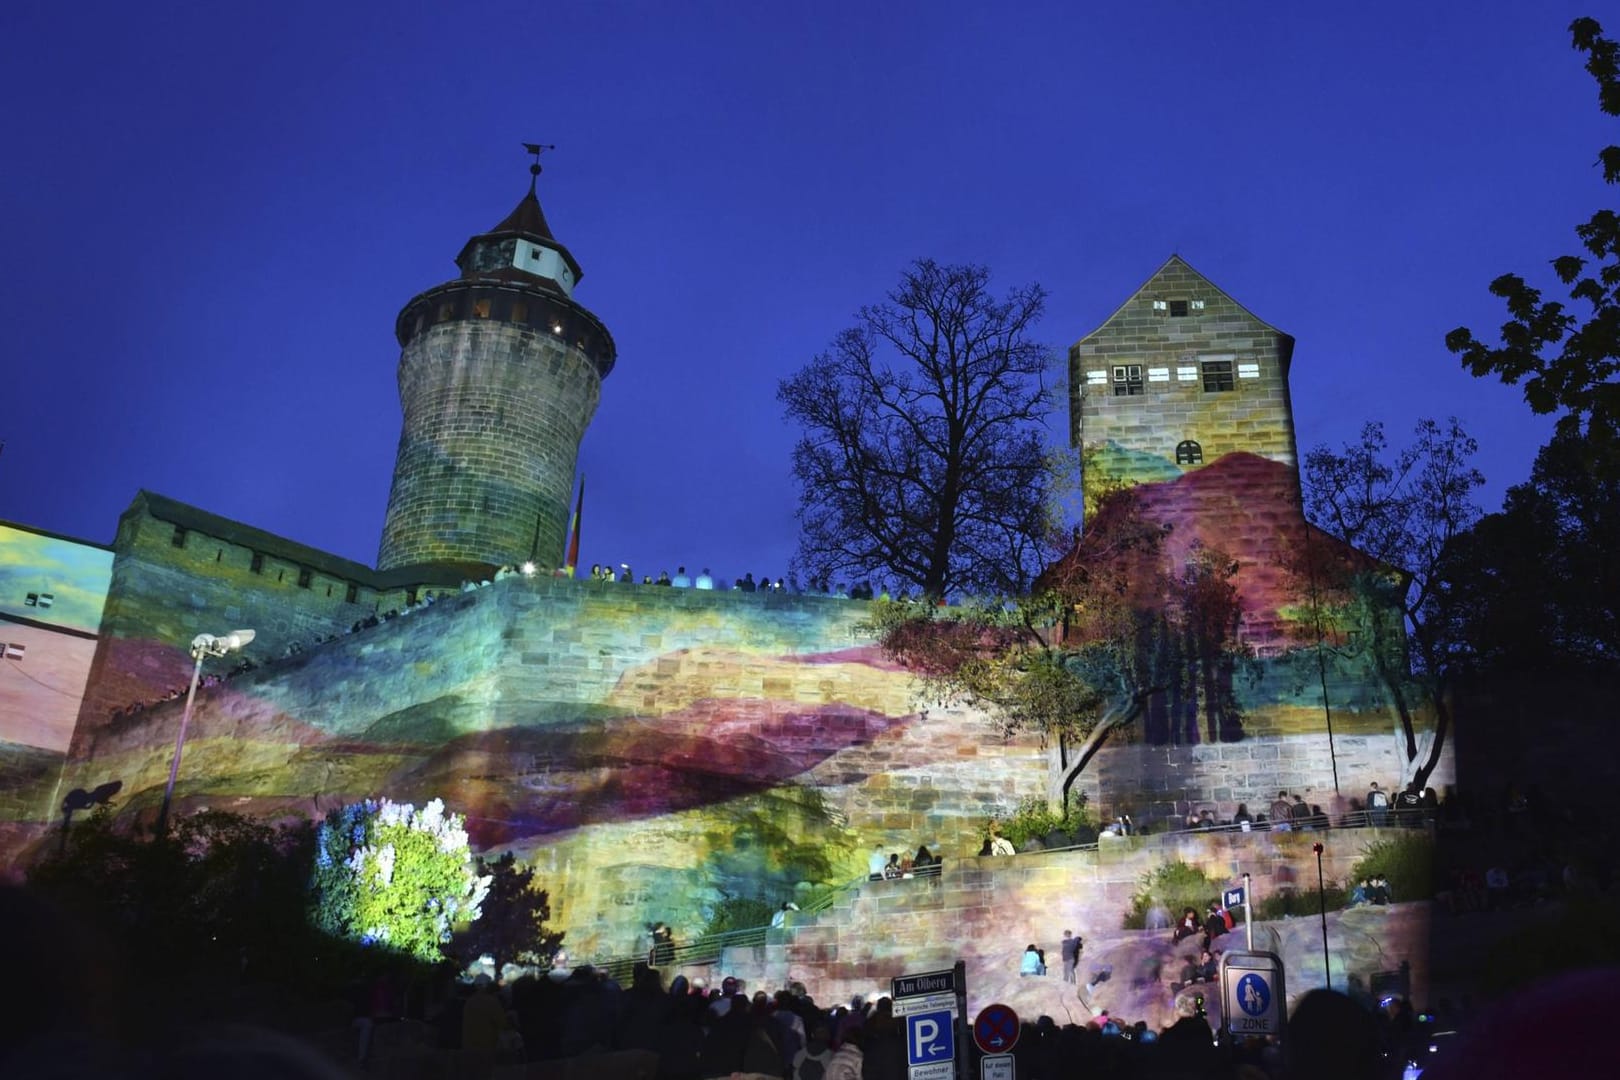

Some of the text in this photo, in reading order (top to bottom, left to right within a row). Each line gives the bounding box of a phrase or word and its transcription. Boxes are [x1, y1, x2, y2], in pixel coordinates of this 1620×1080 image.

[899, 980, 915, 993] Am
[1241, 1018, 1269, 1030] ZONE
[915, 1019, 939, 1058] P
[914, 1066, 948, 1077] Bewohner
